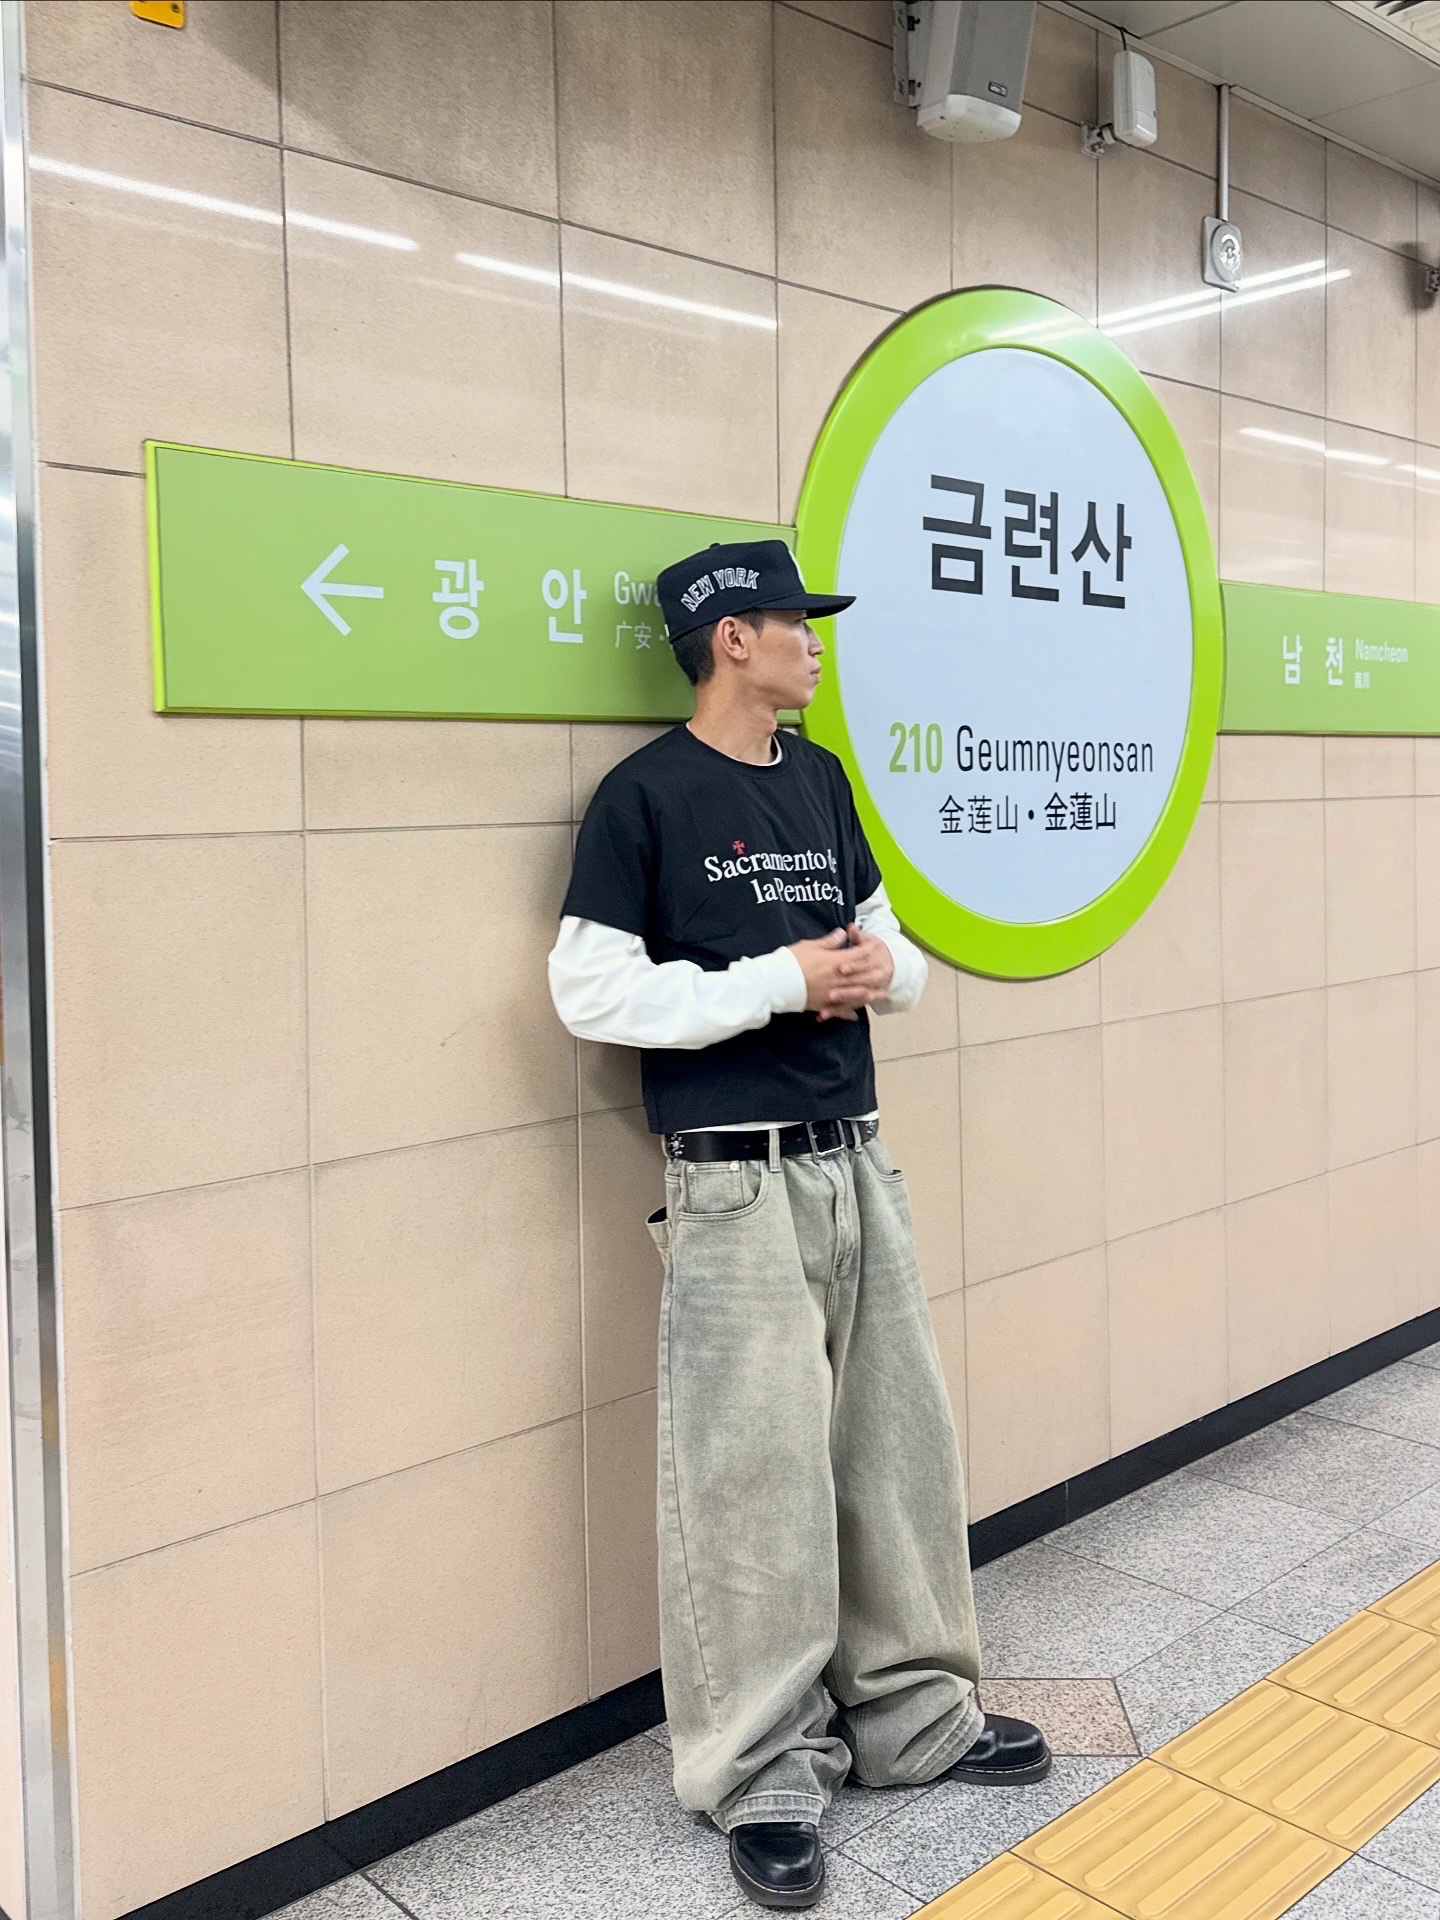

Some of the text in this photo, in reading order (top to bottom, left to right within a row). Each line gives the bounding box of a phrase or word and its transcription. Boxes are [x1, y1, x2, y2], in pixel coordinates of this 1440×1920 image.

[922, 474, 1132, 610] 금련산
[680, 567, 761, 613] NEW YORK
[1354, 637, 1409, 663] Namcheon
[888, 721, 1154, 783] 210 Geumnyeonsan
[703, 849, 827, 883] Sacramento
